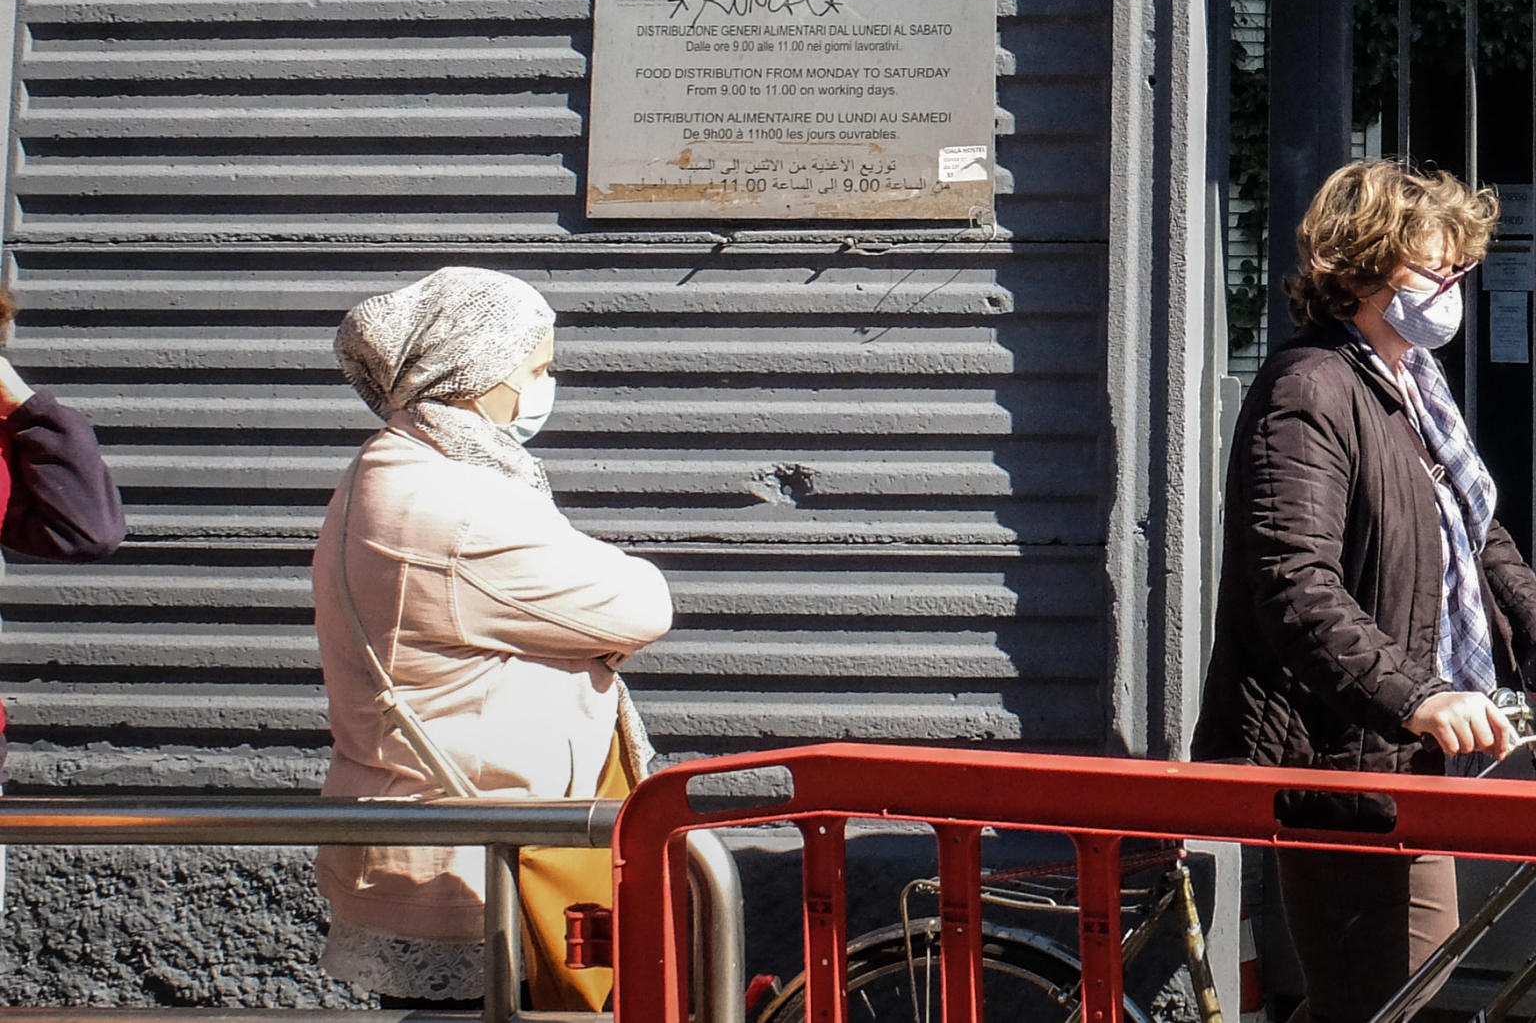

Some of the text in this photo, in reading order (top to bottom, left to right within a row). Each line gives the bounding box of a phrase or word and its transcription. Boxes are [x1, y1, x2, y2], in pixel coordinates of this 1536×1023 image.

[636, 25, 718, 36] DISTRIBUZIONE
[720, 25, 762, 36] GENERI
[763, 25, 827, 36] ALIMENTARI
[829, 25, 850, 36] DAL
[893, 25, 908, 36] AL
[909, 25, 953, 36] SABATO
[686, 40, 711, 52] Dalle
[713, 43, 730, 52] ore
[732, 40, 755, 52] 9.00
[757, 40, 775, 52] alle
[778, 40, 805, 51] 11.00
[806, 40, 822, 51] nei
[824, 40, 852, 54] giorni
[635, 68, 951, 78] FOOD DISTRIBUTION FROM MONDAY TO SATURDAY
[687, 84, 717, 96] From
[720, 84, 747, 95] 9.00
[750, 85, 761, 95] to
[766, 84, 797, 95] 11.00
[800, 86, 815, 95] on
[818, 84, 864, 98] working
[633, 112, 952, 124] DISTRIBUTION ALIMENTAIRE DU LUNDI AU SAMEDI
[683, 128, 700, 139] De
[703, 128, 733, 139] 9h00
[736, 129, 744, 139] à
[749, 128, 783, 139] 11h00
[787, 128, 803, 139] les
[806, 129, 836, 143] jours
[789, 161, 807, 174] من
[860, 160, 897, 176] توزيع
[720, 178, 767, 192] 11.00
[772, 177, 812, 190] الساعة
[843, 178, 880, 192] 9.00
